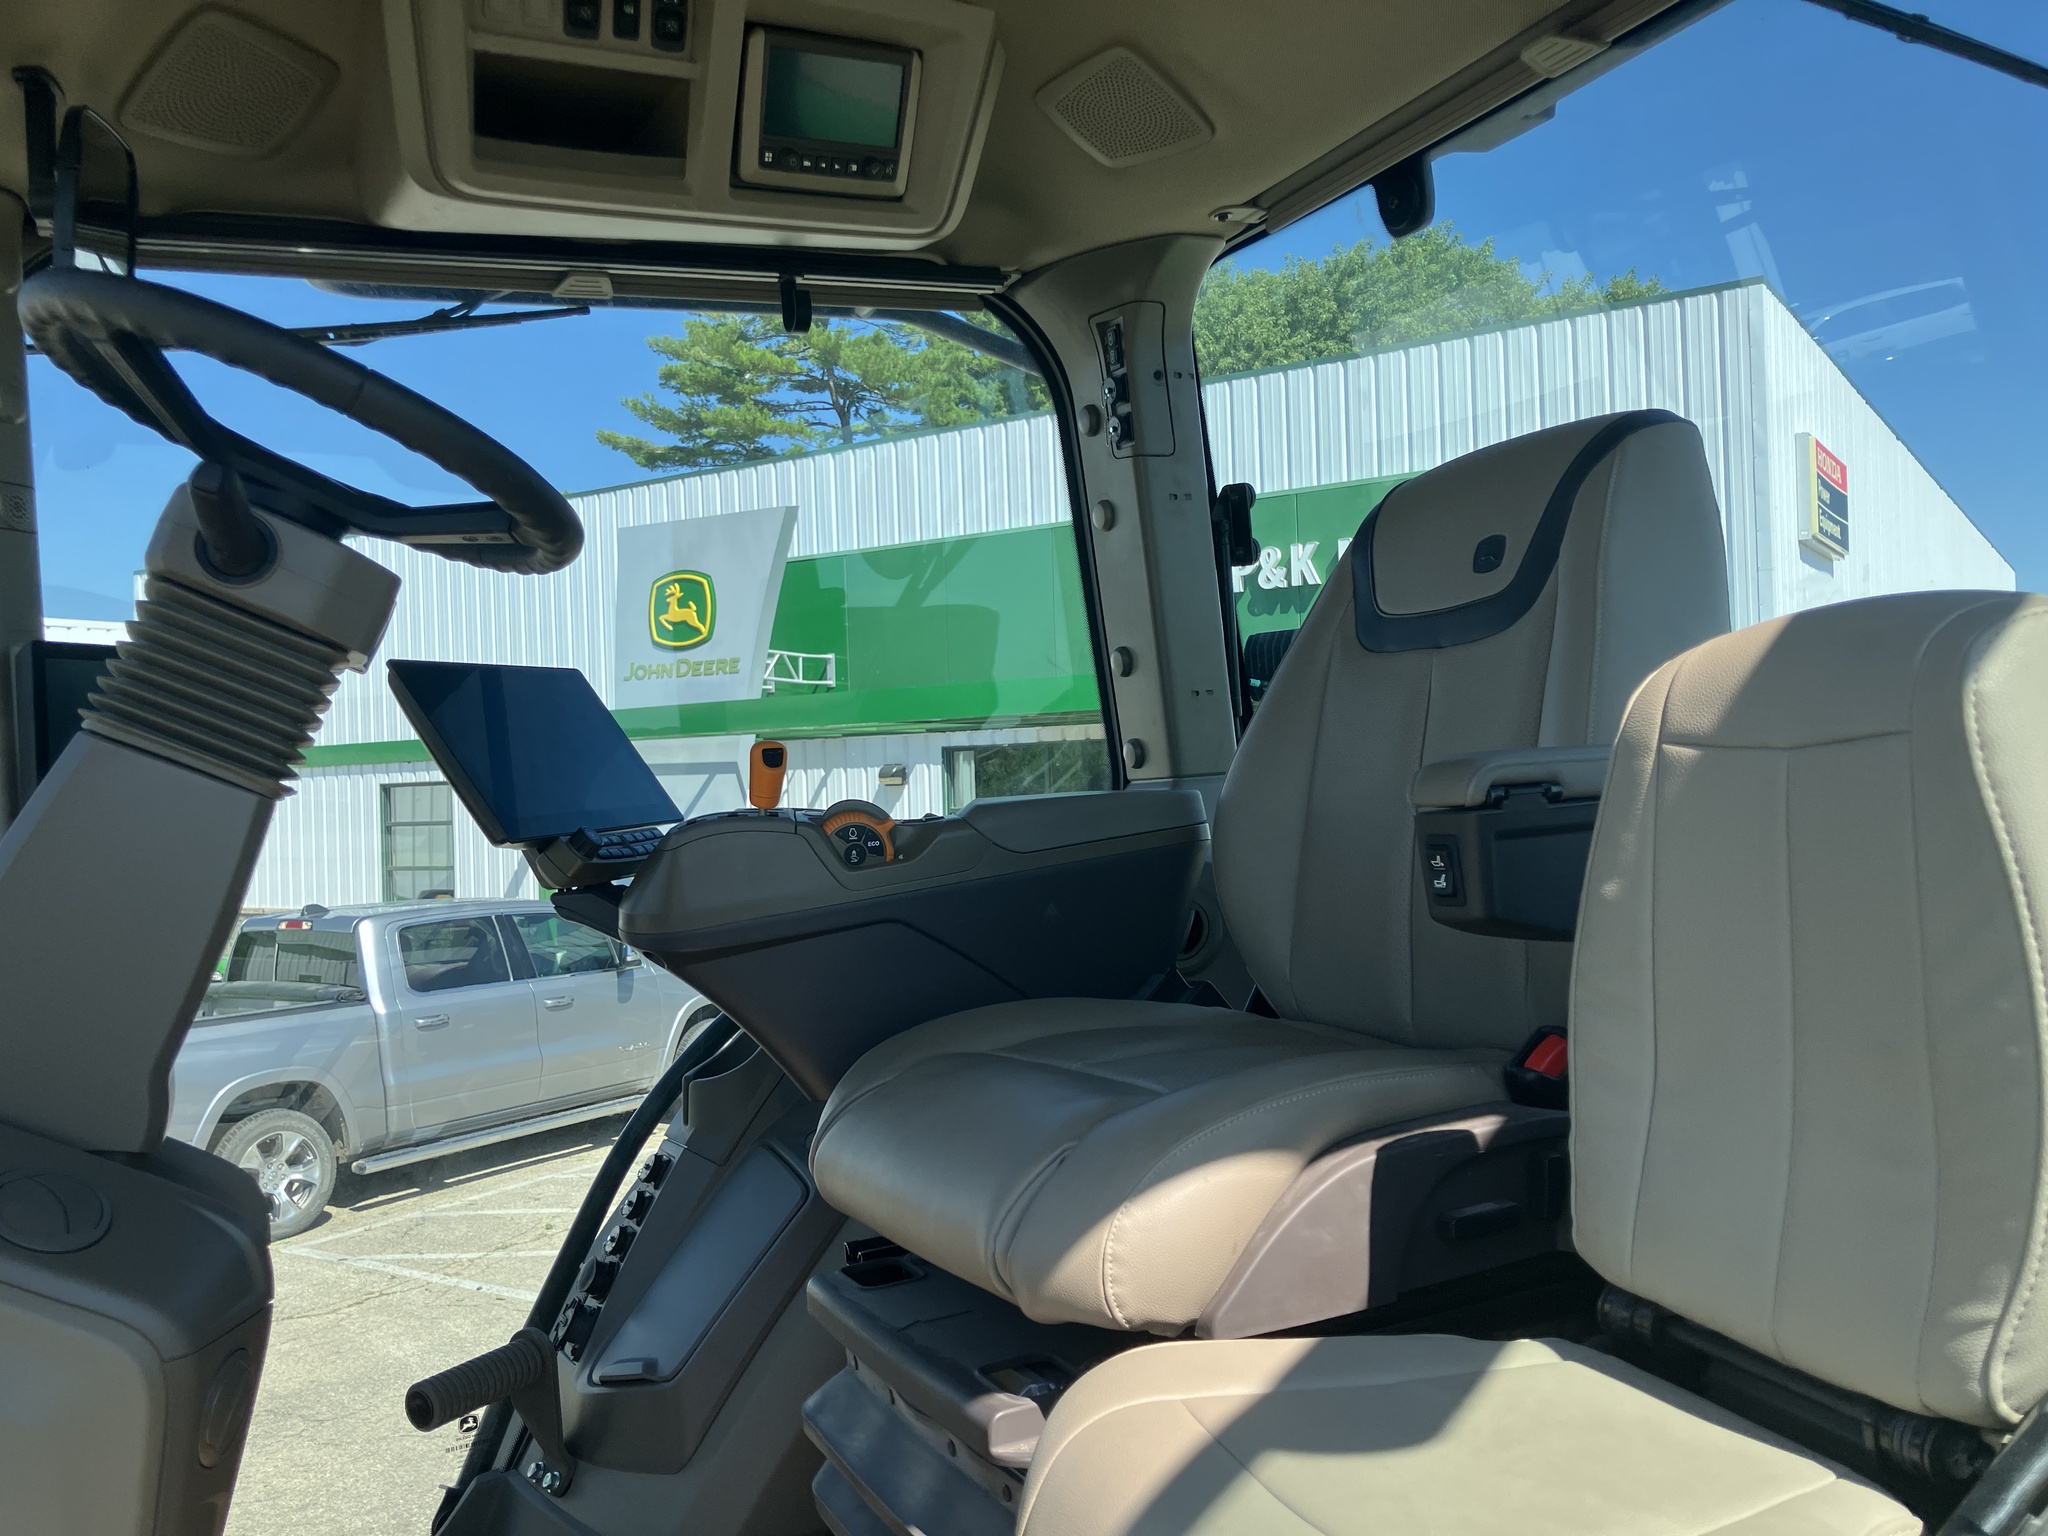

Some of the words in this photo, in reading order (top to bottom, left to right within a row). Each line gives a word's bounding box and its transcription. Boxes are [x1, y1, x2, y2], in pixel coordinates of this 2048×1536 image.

[1817, 447, 1842, 484] HONDA
[623, 662, 674, 682] JOHN
[676, 657, 741, 678] DEERE
